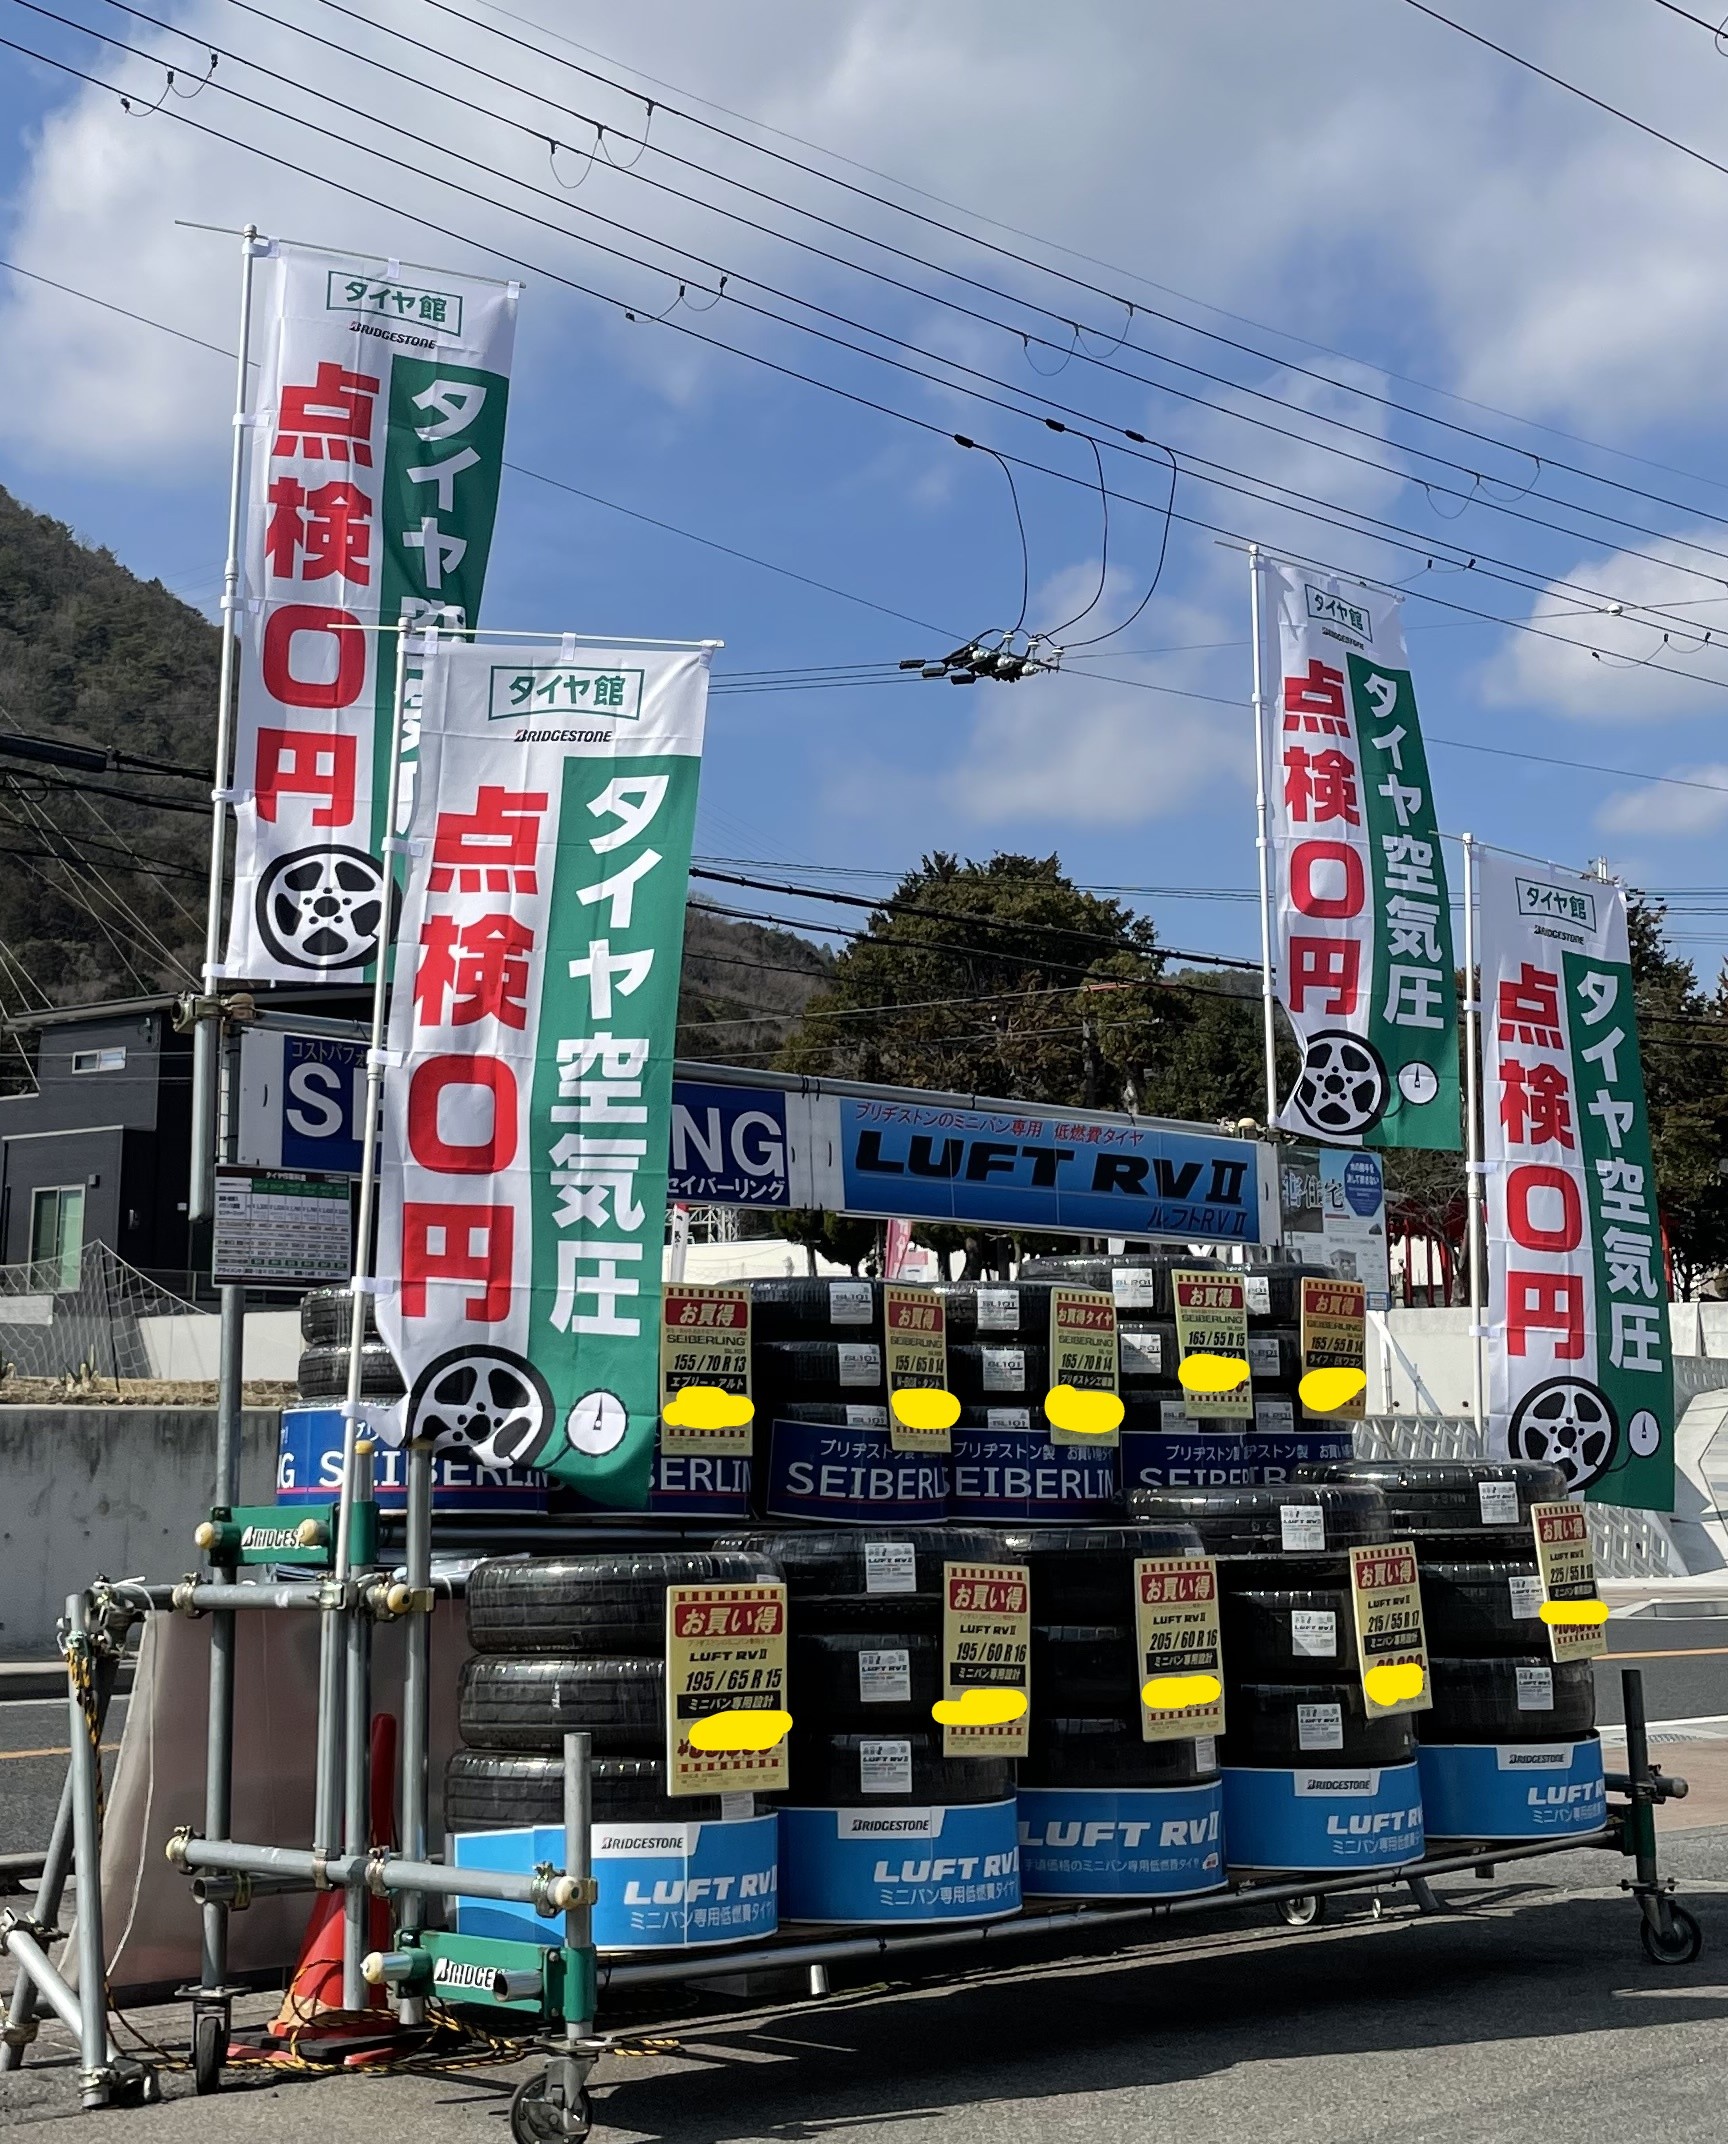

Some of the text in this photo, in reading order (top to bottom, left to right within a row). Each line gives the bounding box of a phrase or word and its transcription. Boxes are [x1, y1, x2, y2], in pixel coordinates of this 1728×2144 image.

[344, 280, 447, 322] タイヤ館
[349, 321, 436, 349] BRIDGESTONE
[1313, 595, 1366, 631] タイヤ館
[508, 674, 624, 708] タイヤ館
[514, 729, 613, 743] BRIDGESTONE
[1363, 672, 1446, 1030] タイヤ空気圧
[1526, 886, 1587, 920] タイヤ館
[549, 775, 670, 1336] タイヤ空気圧
[855, 1129, 1075, 1188] LUFT
[1577, 971, 1664, 1373] タイヤ空気圧
[1190, 1287, 1233, 1308] お買得
[1315, 1294, 1355, 1315] お買得
[680, 1302, 735, 1328] お買得
[898, 1306, 936, 1330] お買得
[1058, 1307, 1113, 1327] お買得タイヤ
[241, 1526, 301, 1548] BRIDGES
[1543, 1519, 1584, 1541] お買い得
[1362, 1560, 1412, 1586] お買い得
[954, 1584, 1024, 1611] お買い得
[1146, 1575, 1211, 1602] お買い得
[1368, 1599, 1392, 1609] LUFT
[682, 1606, 778, 1635] お買い得
[960, 1625, 991, 1634] LUFT
[1153, 1615, 1182, 1625] LUFT
[690, 1651, 733, 1662] LUFT
[1509, 1753, 1565, 1765] BRIDGESTONE
[1307, 1779, 1371, 1791] BRIDGESTONE
[1527, 1782, 1594, 1807] LUFT
[853, 1819, 929, 1832] BRIDGESTONE
[1018, 1821, 1151, 1848] LUFT
[1327, 1811, 1405, 1835] LUFT
[601, 1837, 683, 1850] BRIDGESTONE
[873, 1856, 980, 1884] LUFT
[623, 1876, 736, 1906] LUFT
[436, 1958, 500, 1989] BRIDGE
